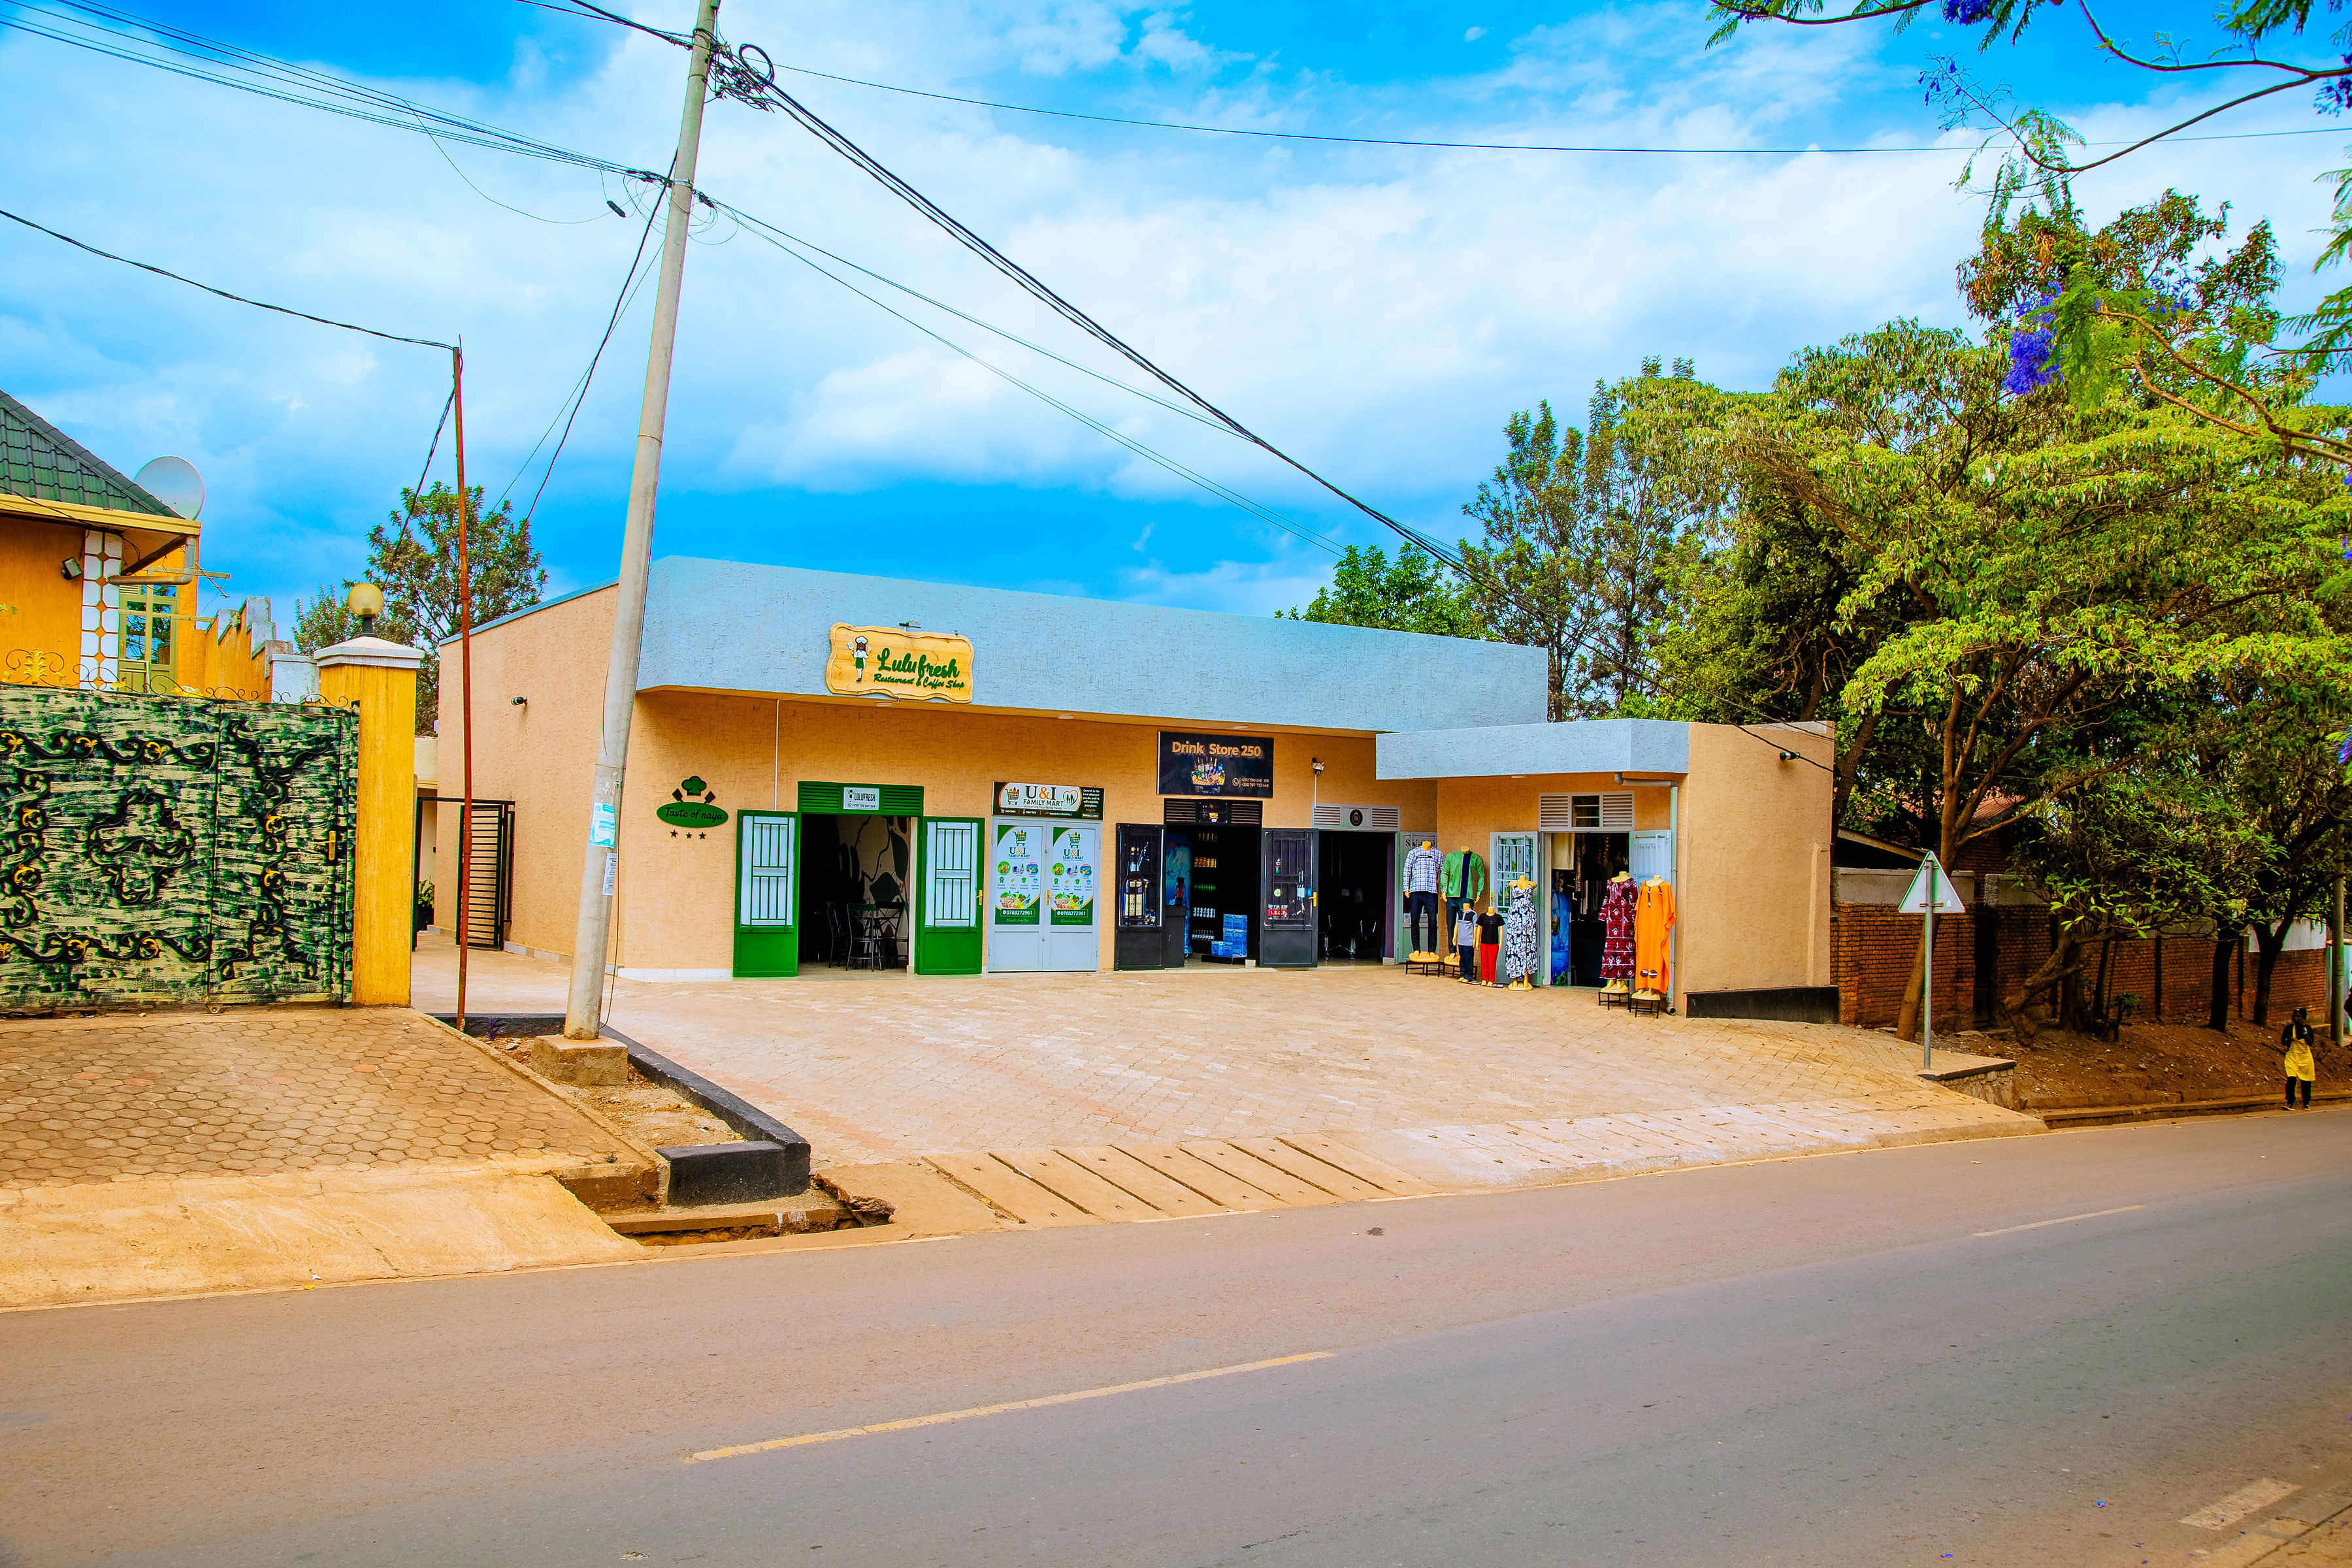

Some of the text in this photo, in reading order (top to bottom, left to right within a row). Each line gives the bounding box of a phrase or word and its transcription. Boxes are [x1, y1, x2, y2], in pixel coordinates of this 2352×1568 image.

[874, 673, 964, 689] Restaurant & Coffee Shop
[1171, 741, 1262, 757] Drink Store 250
[854, 792, 875, 802] LULUFRESH
[1025, 785, 1056, 800] U&I
[665, 807, 723, 823] Taste of naija
